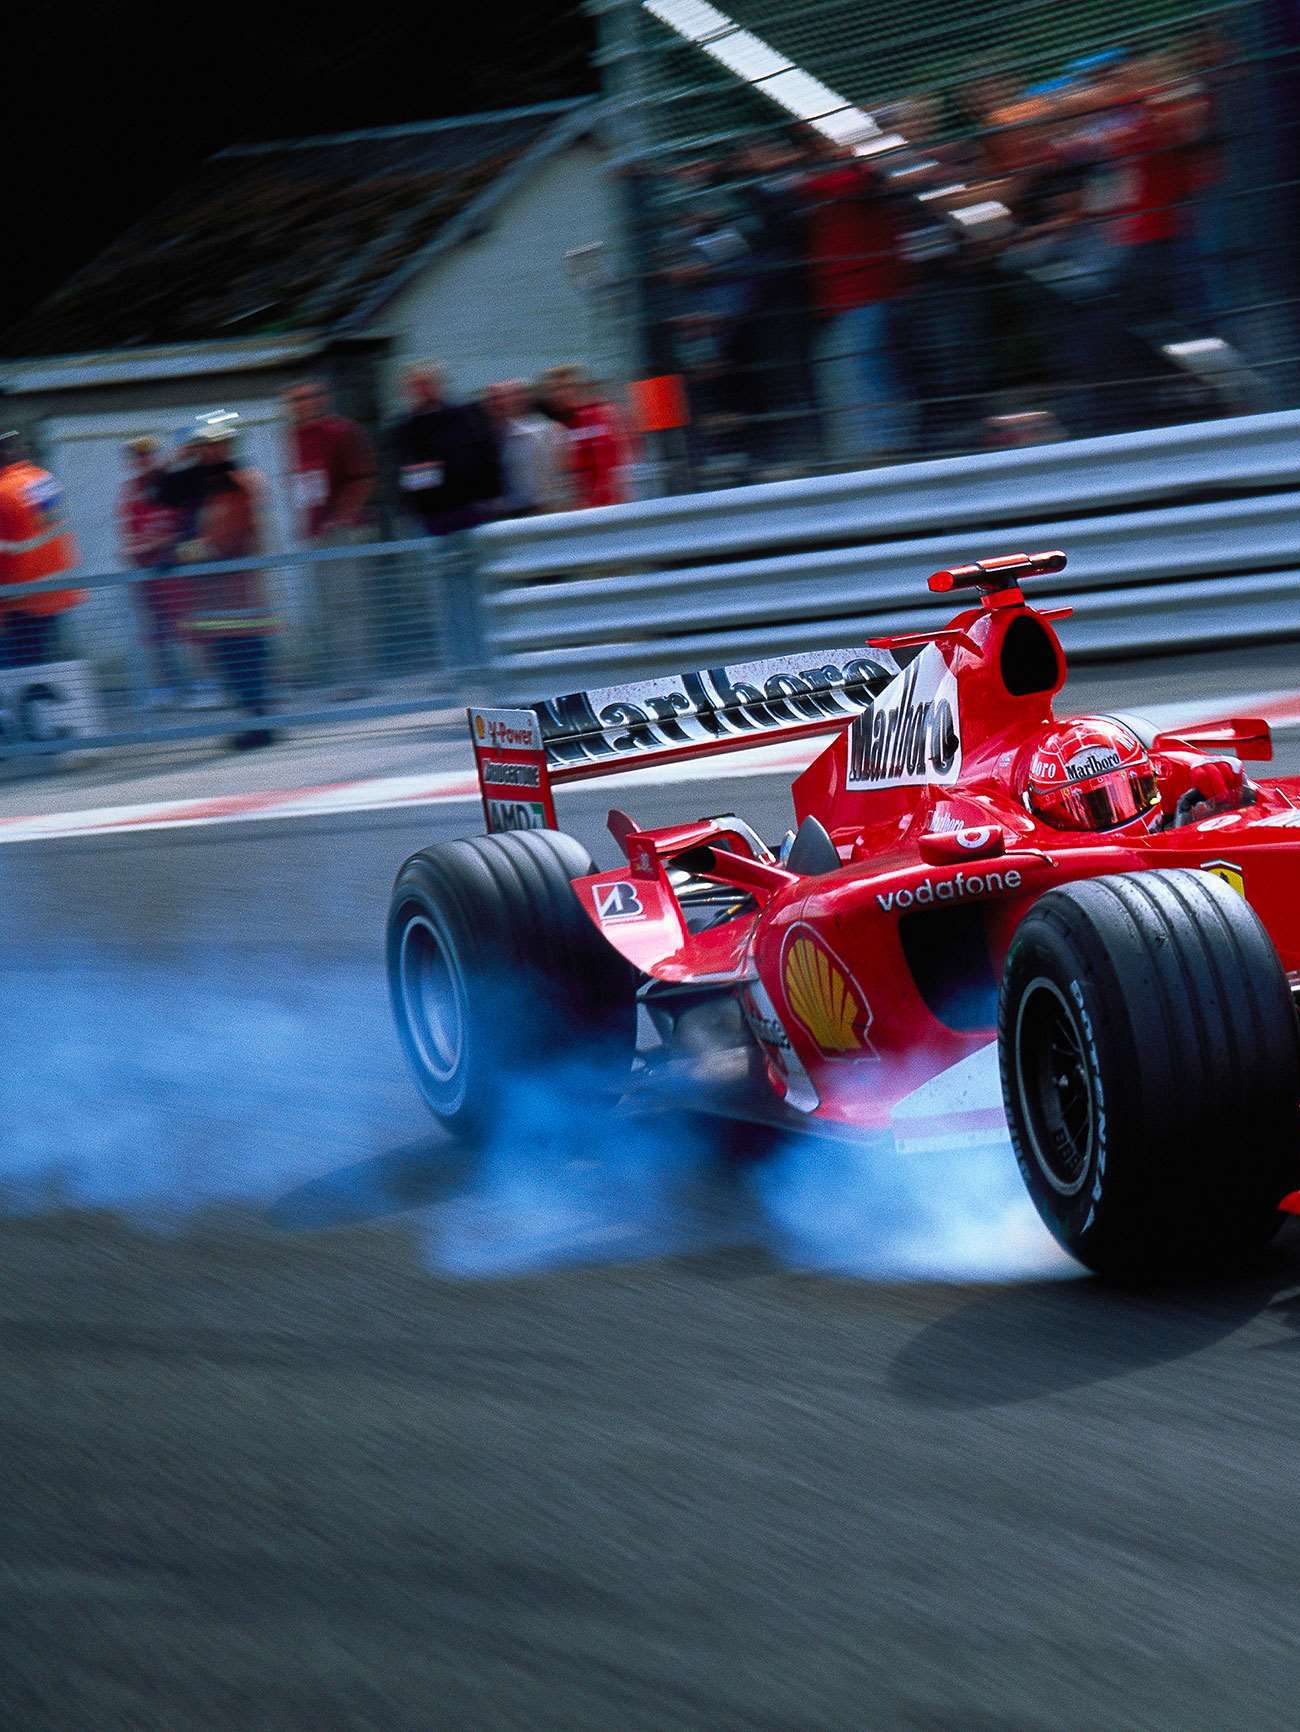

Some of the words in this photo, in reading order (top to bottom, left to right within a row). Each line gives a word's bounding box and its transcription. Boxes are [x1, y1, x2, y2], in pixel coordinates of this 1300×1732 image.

[532, 658, 898, 766] Marlboro
[850, 653, 959, 782] Marlboro
[1065, 753, 1120, 781] Marlboro
[489, 801, 532, 832] AMD
[876, 869, 1022, 912] vodafone
